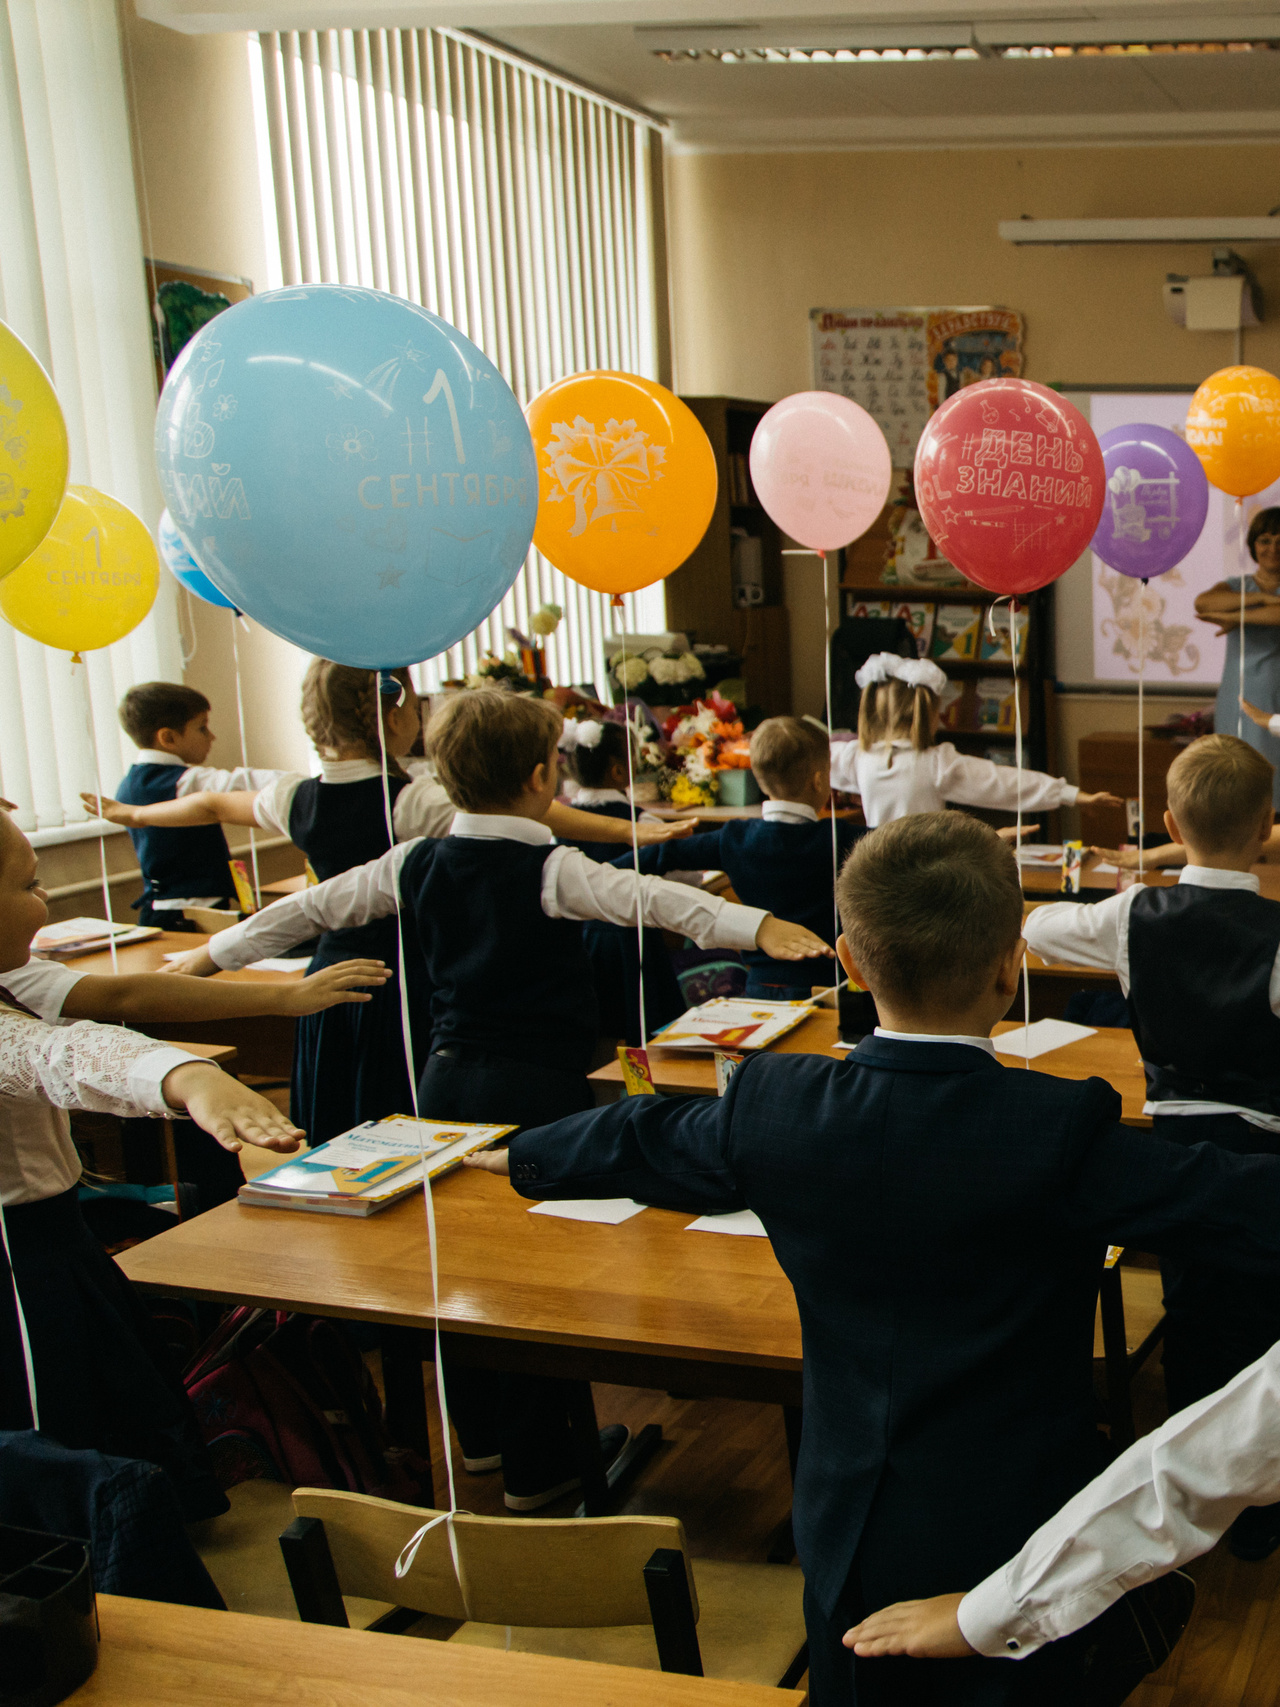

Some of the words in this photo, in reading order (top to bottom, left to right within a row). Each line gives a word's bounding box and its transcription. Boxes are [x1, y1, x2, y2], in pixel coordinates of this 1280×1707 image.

[961, 427, 1085, 473] #ДЕНЬ
[357, 472, 528, 510] СЕНТЯБРЯ
[956, 465, 1093, 508] ЗНАНИЙ
[46, 569, 142, 587] СЕНТЯБРЯ
[343, 1133, 430, 1150] Математика
